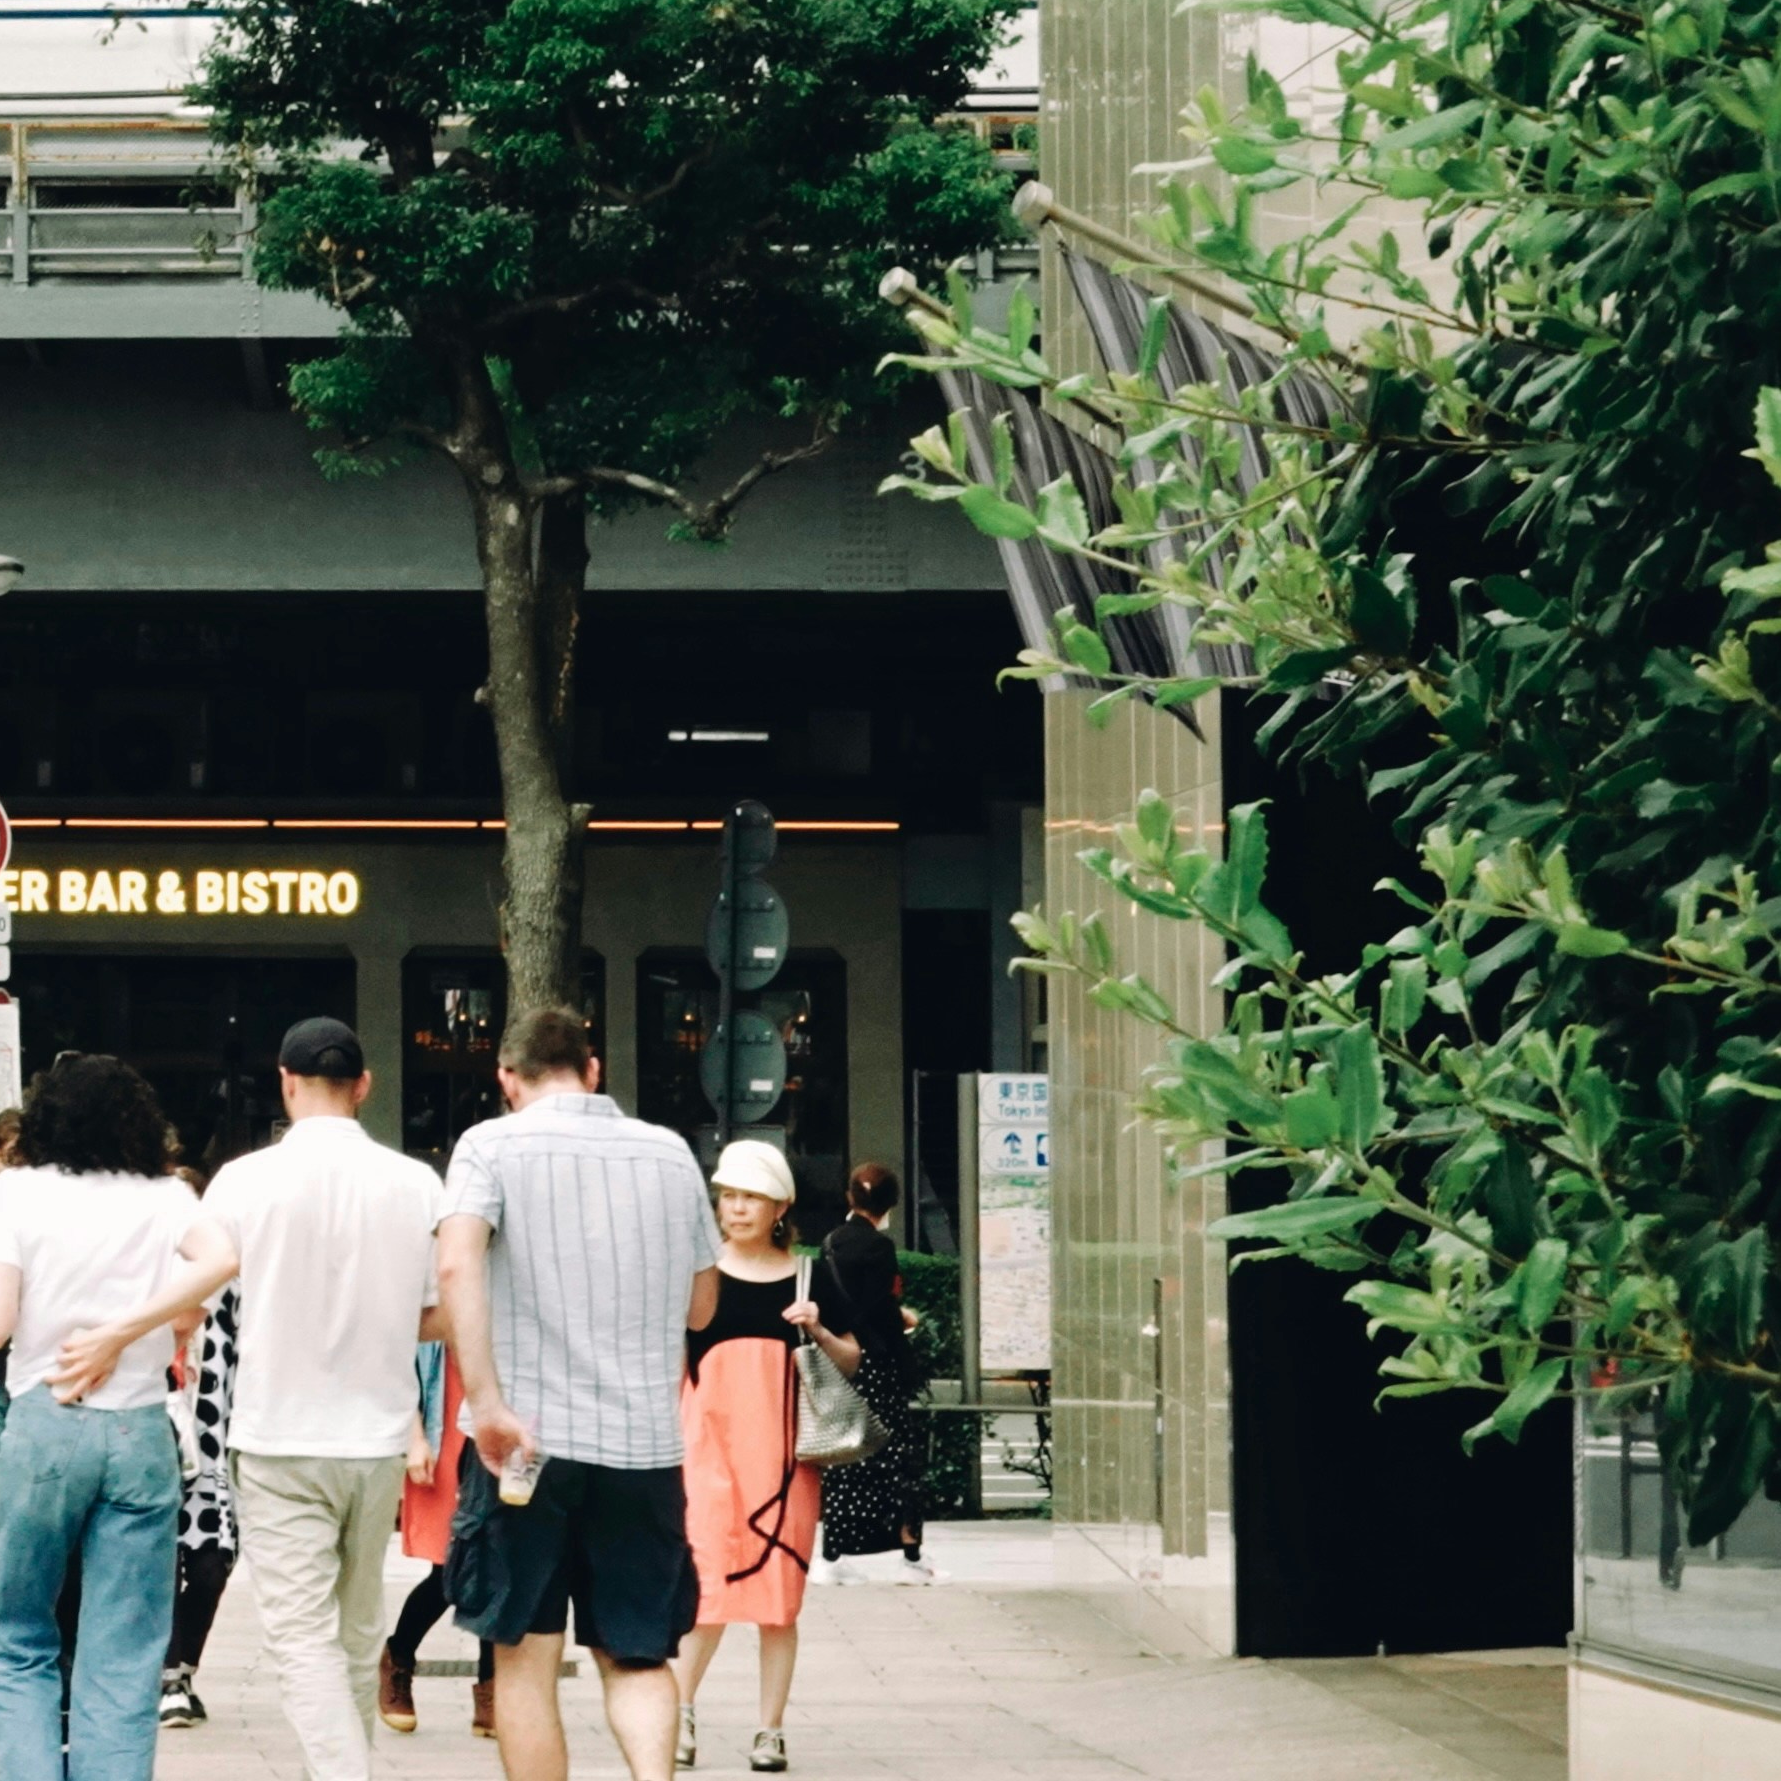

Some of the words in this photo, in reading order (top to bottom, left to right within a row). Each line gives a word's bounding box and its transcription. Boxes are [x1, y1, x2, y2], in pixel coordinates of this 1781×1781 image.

[58, 871, 147, 913] BAR
[155, 872, 186, 913] &
[196, 871, 359, 915] BISTRO
[998, 1103, 1031, 1120] Tokyo
